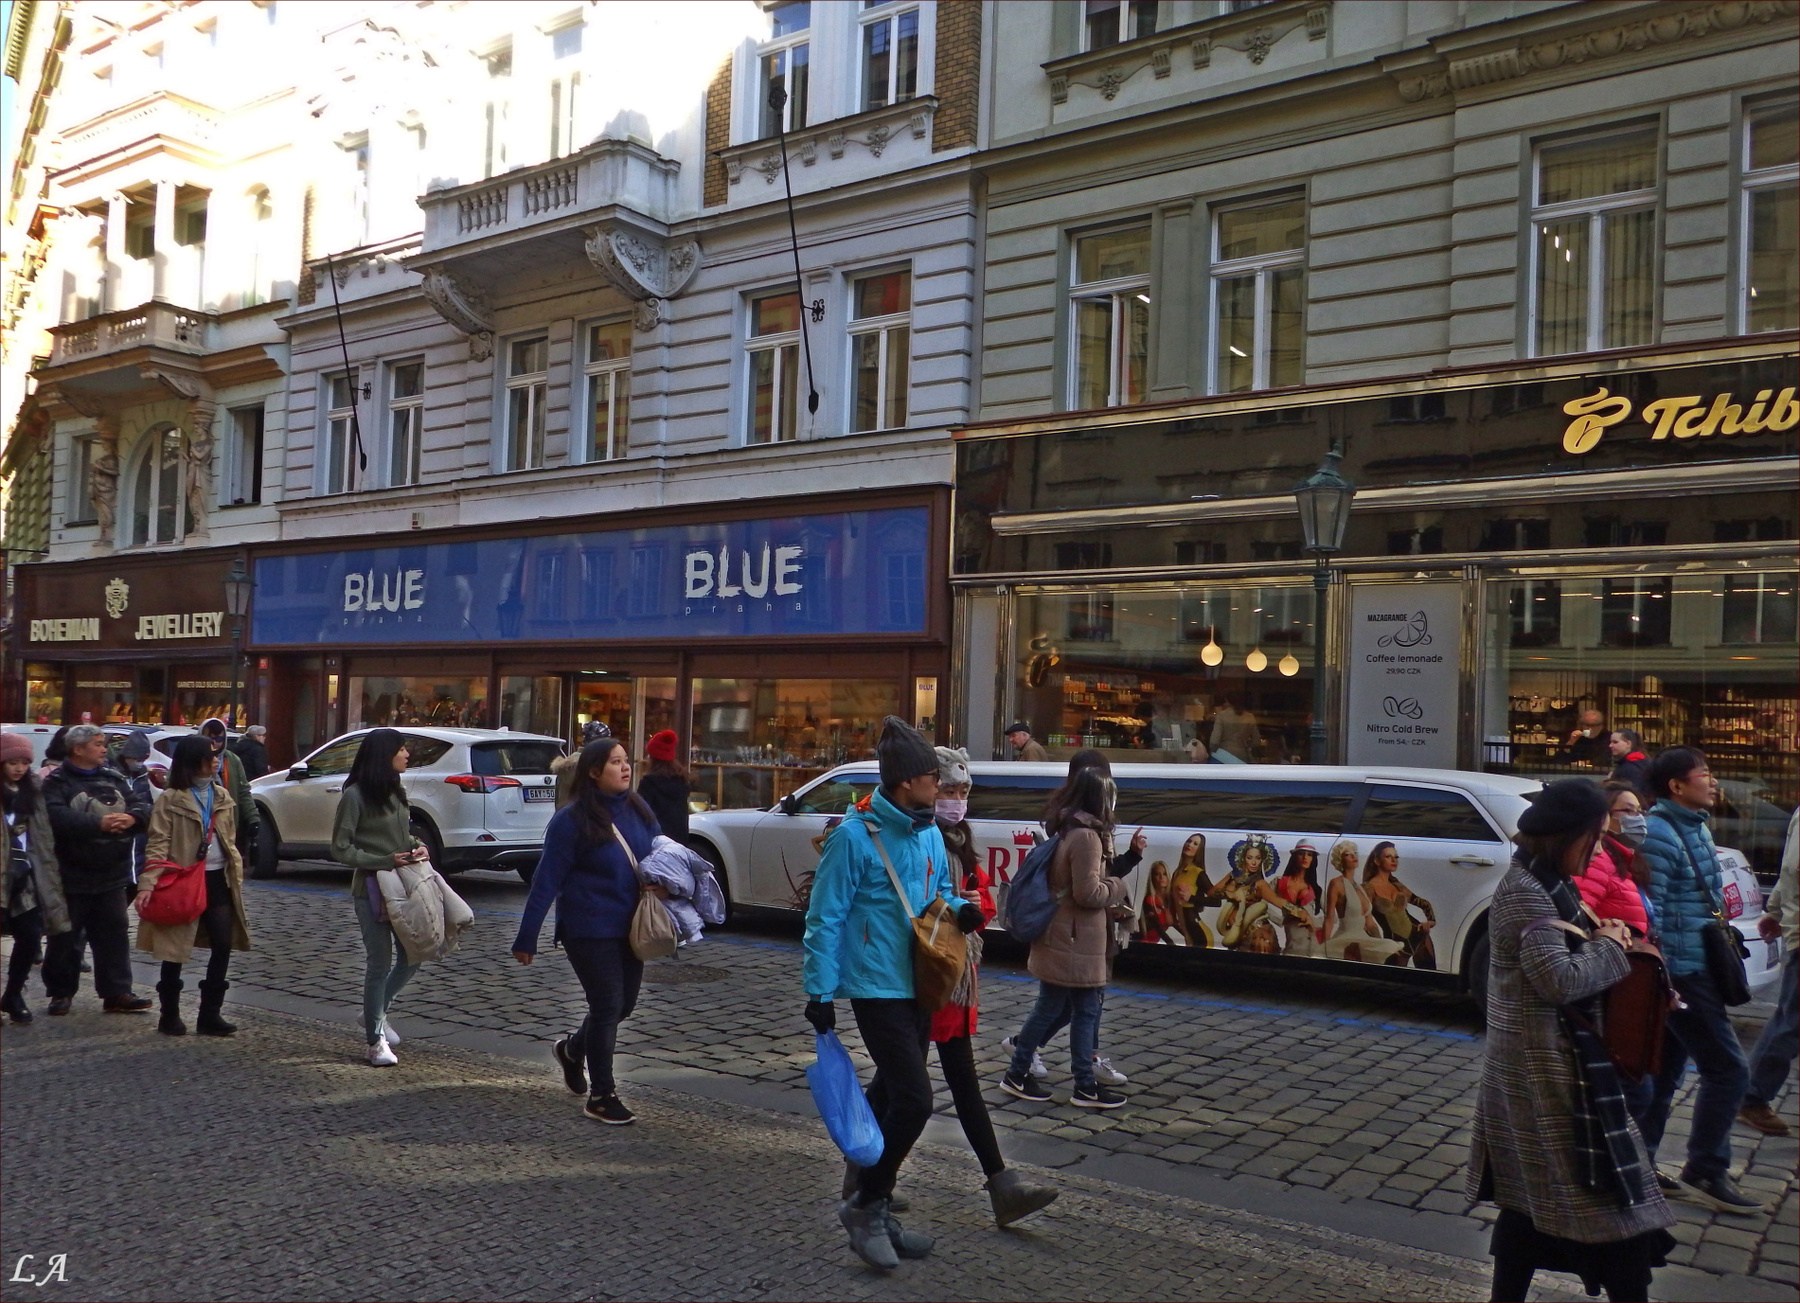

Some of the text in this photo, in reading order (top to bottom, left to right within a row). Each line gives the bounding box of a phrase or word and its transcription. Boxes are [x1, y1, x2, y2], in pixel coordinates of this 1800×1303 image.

[685, 541, 803, 599] BLUE
[344, 565, 423, 612] BLUE
[685, 602, 801, 616] praha
[1367, 614, 1407, 622] MAZAGRANDE
[30, 612, 225, 641] BOHEMIAN JEWELLERY
[1366, 654, 1443, 663] Coffee lemonade
[1366, 724, 1439, 734] Nitro Cold Brew
[1411, 738, 1426, 746] CZK
